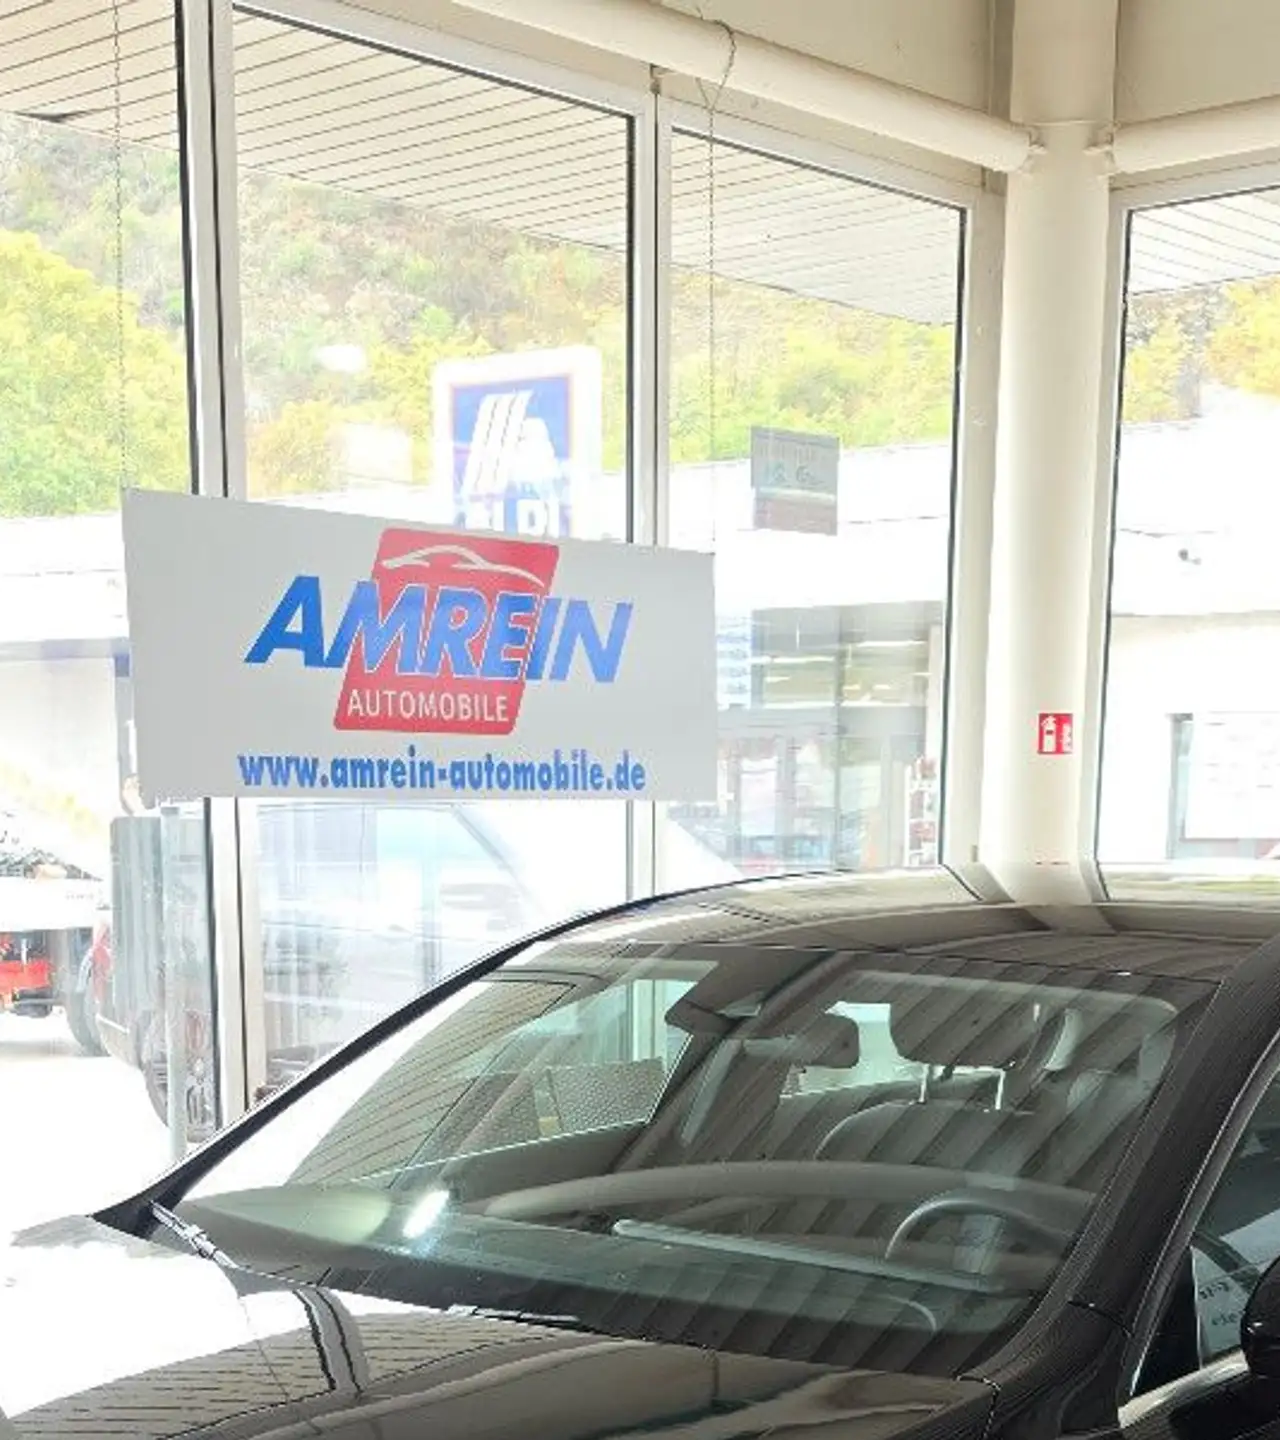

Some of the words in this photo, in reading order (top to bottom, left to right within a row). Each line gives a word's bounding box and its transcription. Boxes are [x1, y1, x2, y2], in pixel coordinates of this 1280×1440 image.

[243, 573, 632, 684] AMREIN
[347, 690, 510, 723] AUTOMOBILE
[237, 745, 646, 792] www.amrein-automobile.de
